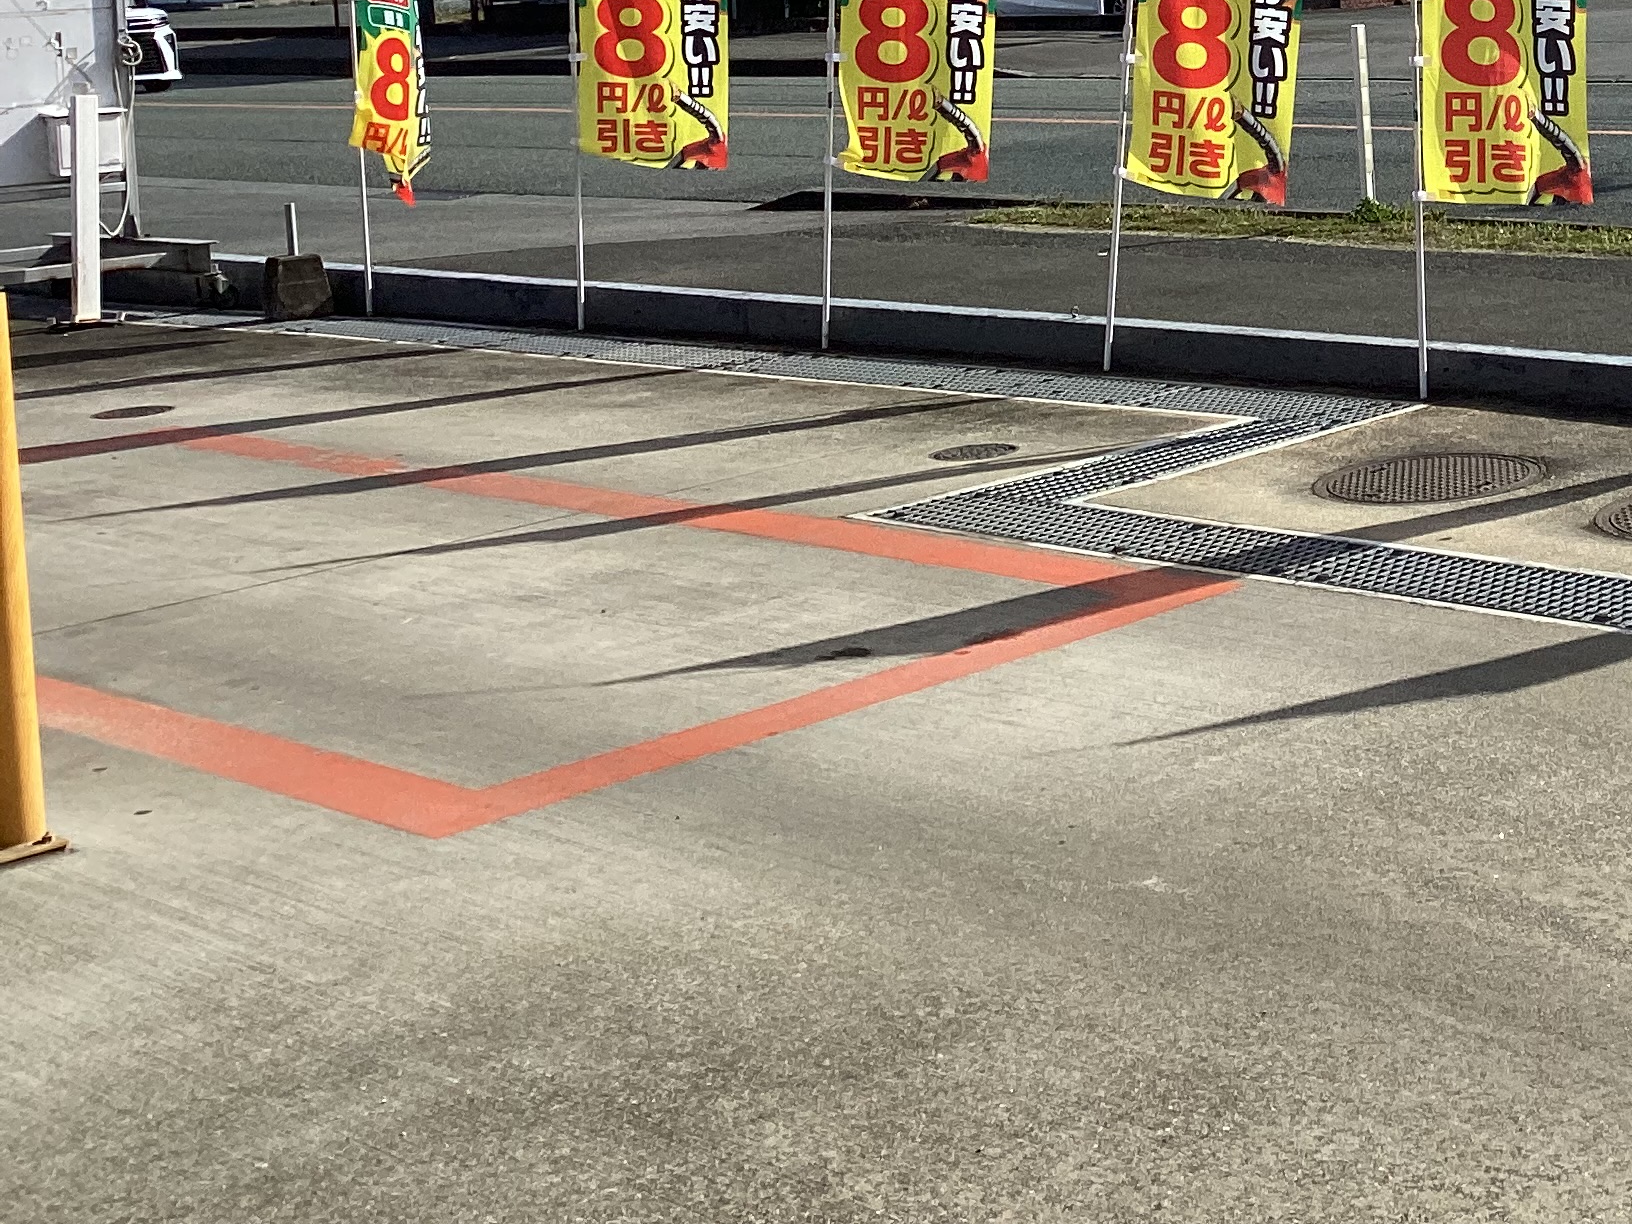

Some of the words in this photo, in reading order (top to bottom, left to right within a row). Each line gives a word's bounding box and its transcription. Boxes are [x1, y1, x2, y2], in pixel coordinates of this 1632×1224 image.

[370, 38, 410, 121] 8
[596, 119, 668, 153] 引き
[859, 127, 929, 163] 引き
[1150, 132, 1226, 178] 引き
[1445, 139, 1526, 183] 引き
